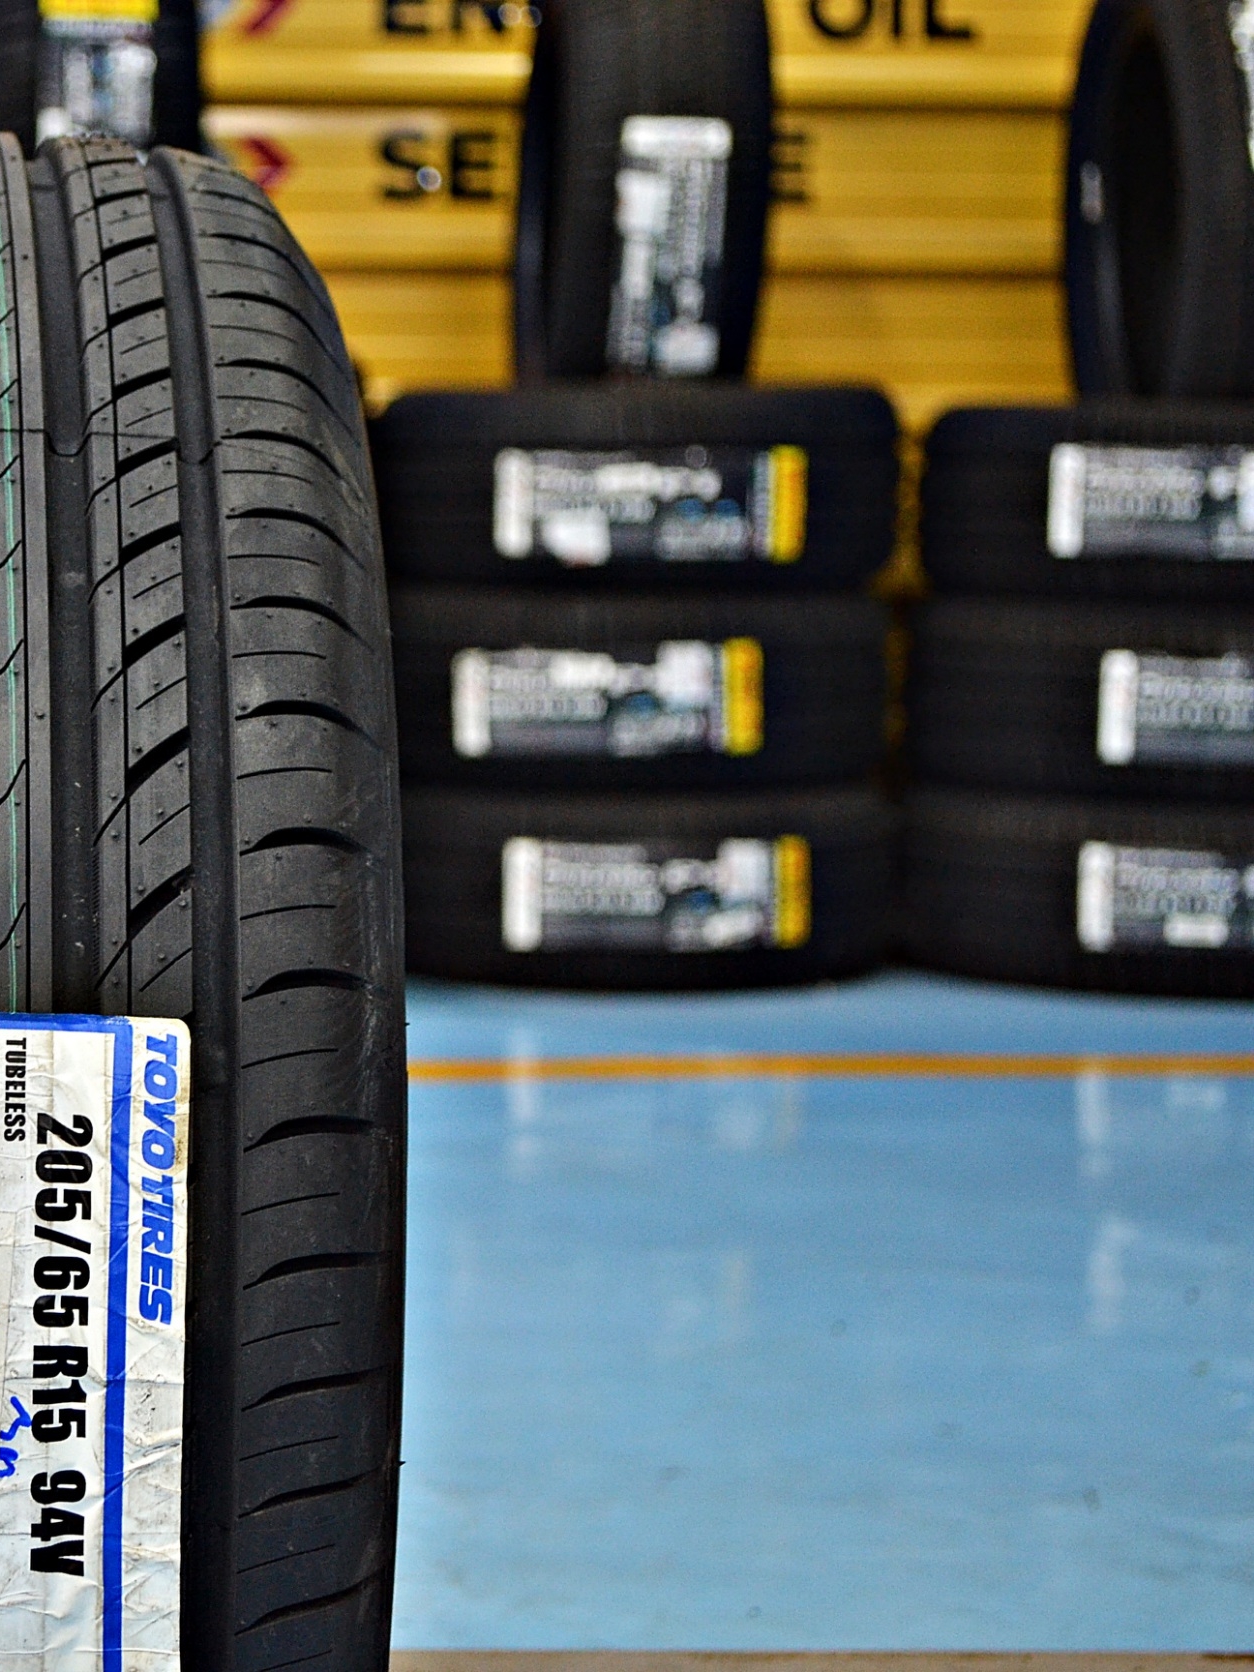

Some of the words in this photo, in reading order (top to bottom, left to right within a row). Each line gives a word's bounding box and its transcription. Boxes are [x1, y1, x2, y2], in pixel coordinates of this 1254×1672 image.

[4, 1037, 26, 1142] TUBELESS
[142, 1034, 178, 1170] TOYO
[33, 1113, 93, 1328] 205/65
[139, 1175, 174, 1325] TIRES
[31, 1345, 88, 1443] R15
[30, 1470, 86, 1576] 94V
